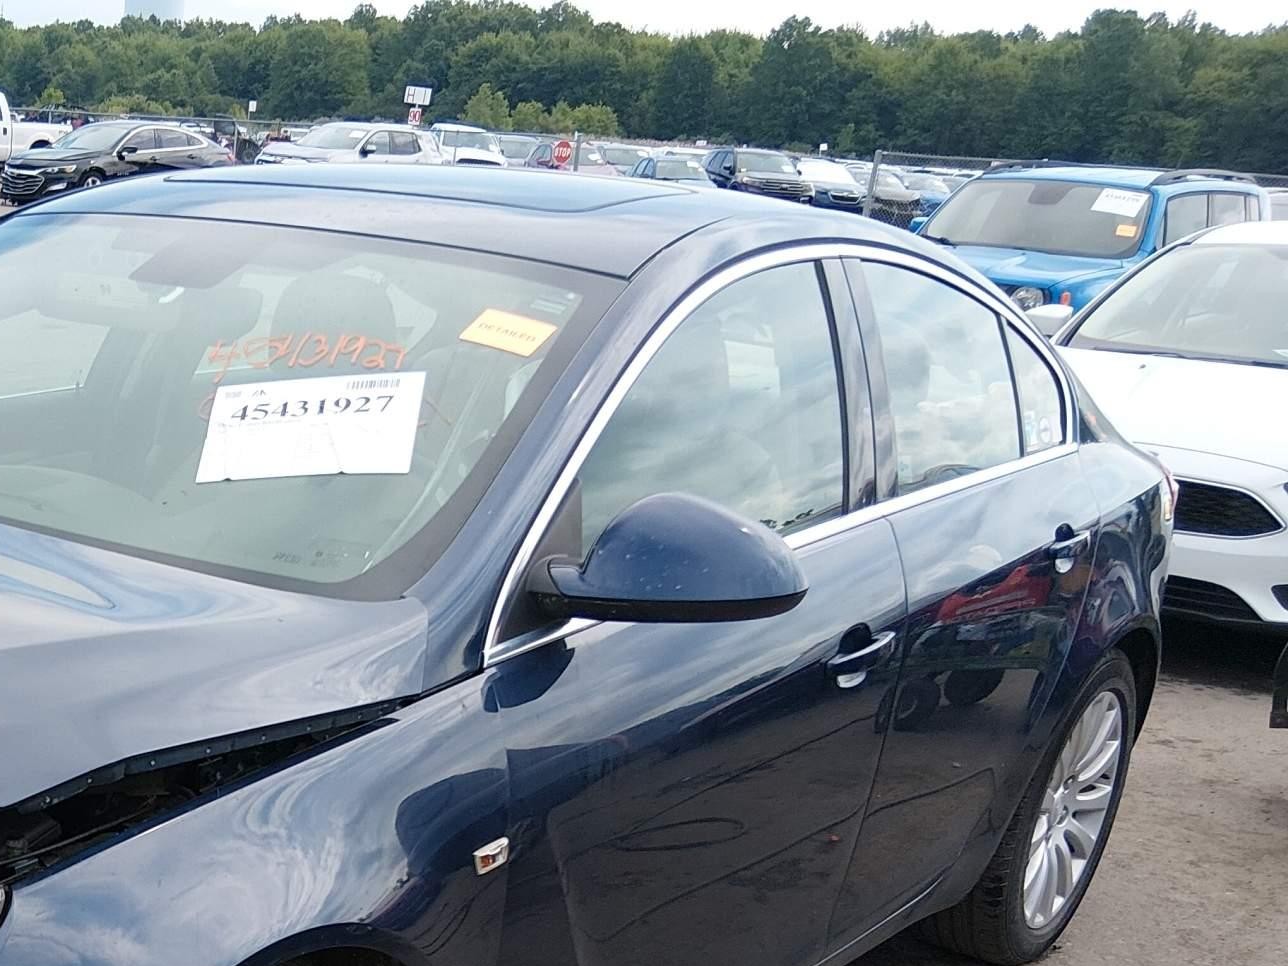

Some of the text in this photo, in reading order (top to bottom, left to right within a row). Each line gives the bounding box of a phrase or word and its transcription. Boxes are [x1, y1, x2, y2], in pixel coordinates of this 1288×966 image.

[407, 87, 416, 102] H
[554, 146, 571, 157] STOP
[231, 395, 395, 421] 45431927
